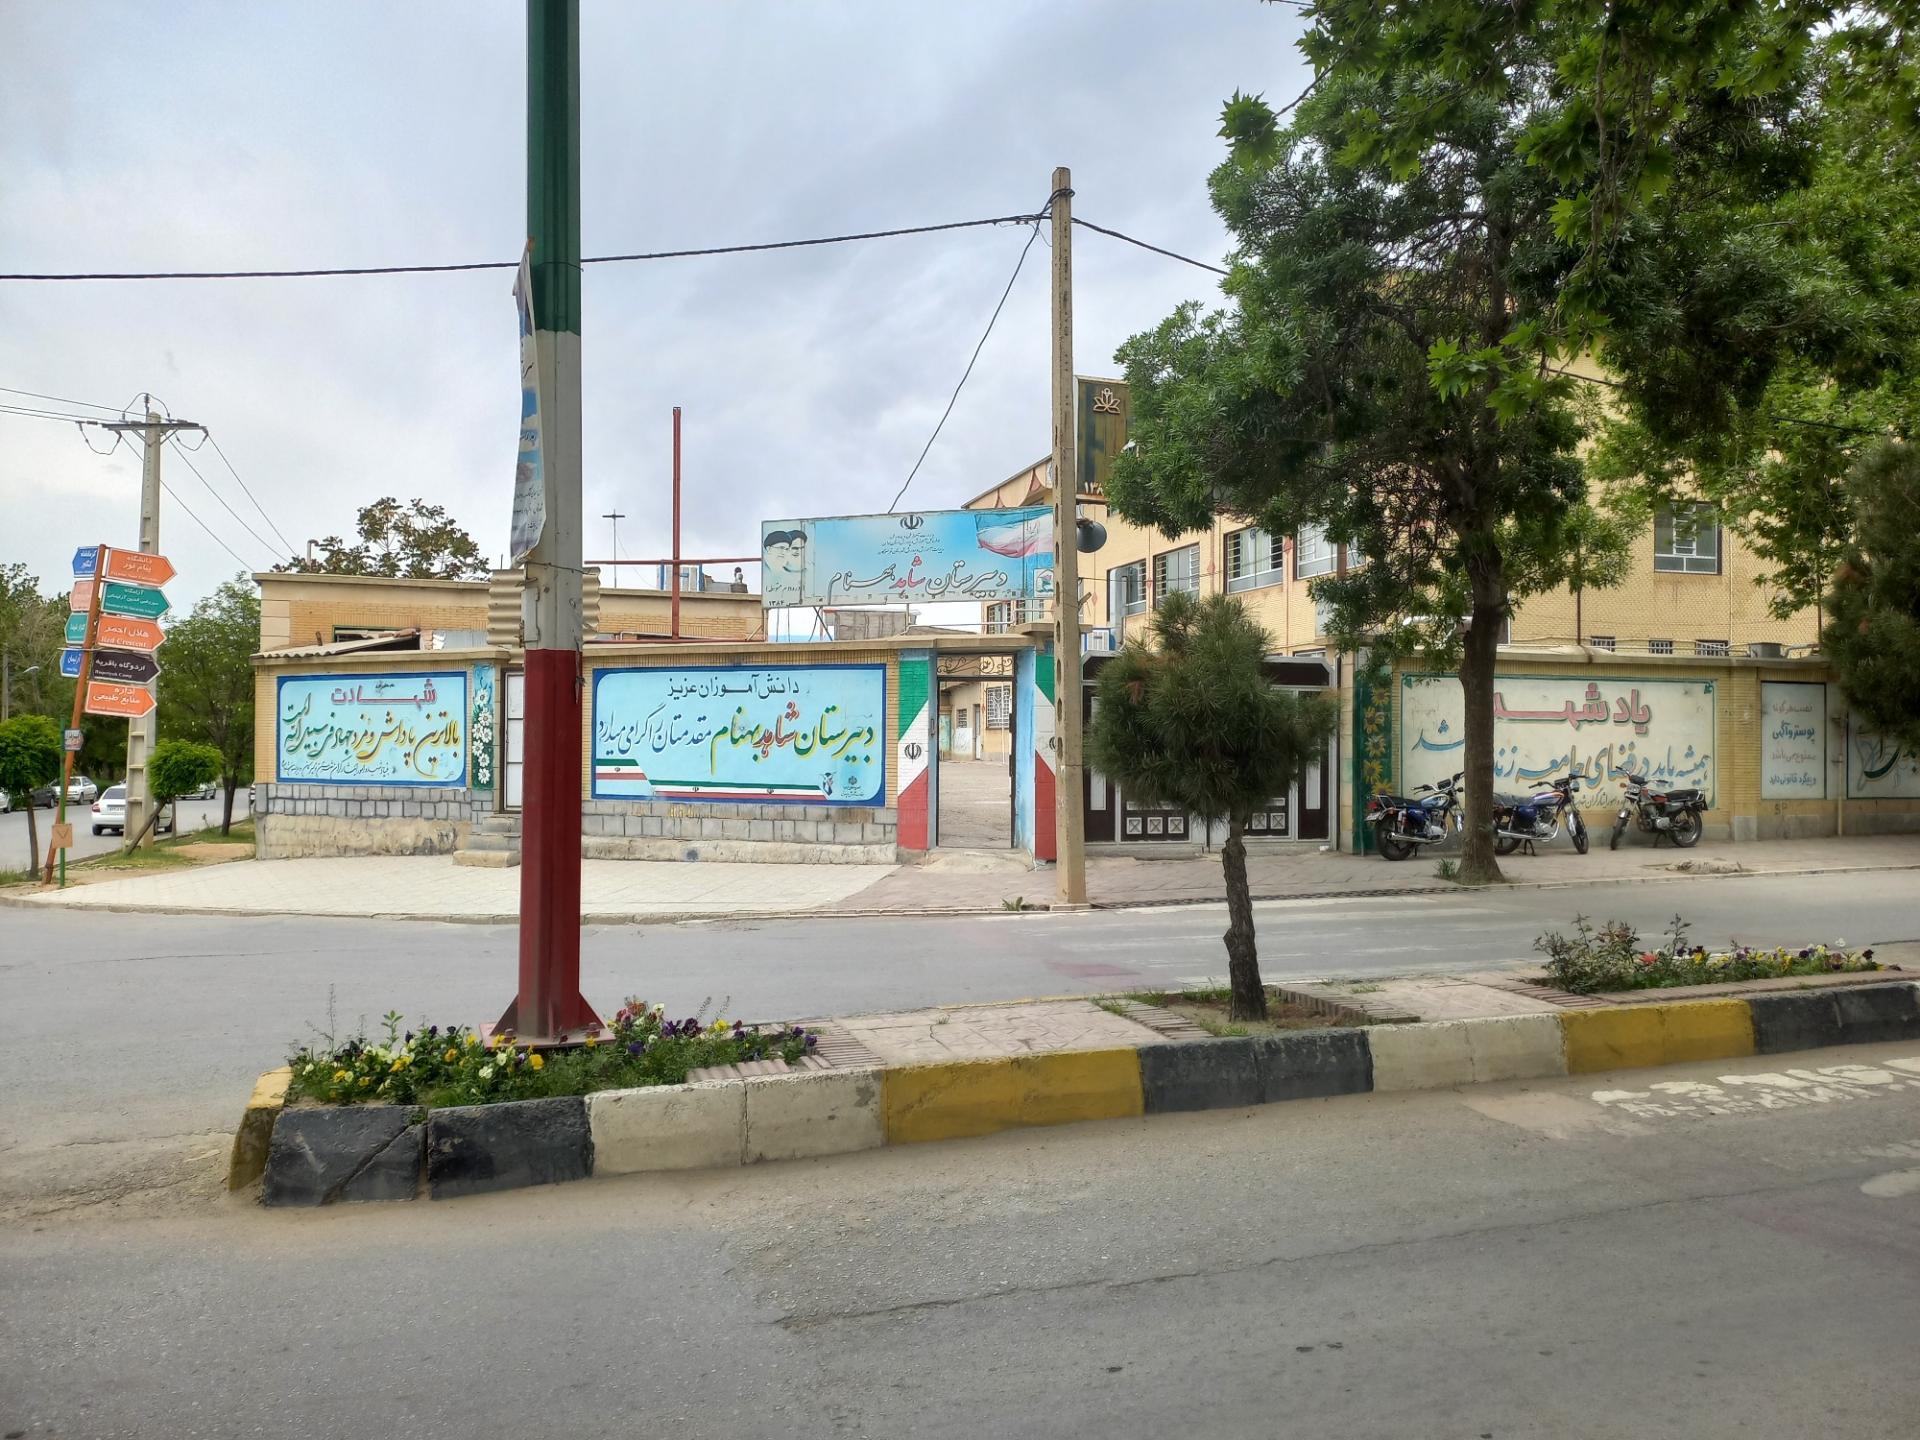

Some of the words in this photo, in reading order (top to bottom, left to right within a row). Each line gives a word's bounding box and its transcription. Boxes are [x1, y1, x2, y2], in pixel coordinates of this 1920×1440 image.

[122, 562, 136, 571] نور
[126, 554, 153, 565] دانشگاه
[136, 563, 152, 573] پیام
[828, 562, 897, 605] بهنام
[890, 555, 925, 599] شاهد
[925, 559, 1008, 598] دبیرستان
[103, 625, 127, 635] احمر
[128, 628, 150, 638] هلال
[95, 658, 117, 668] باقریه
[118, 661, 146, 672] اردوگاه
[92, 693, 119, 702] طبیعی
[114, 686, 136, 696] اداره
[120, 695, 141, 706] منابع
[331, 678, 438, 711] شهادت
[667, 677, 697, 701] عزیز
[698, 674, 760, 698] آموزان
[758, 673, 800, 700] دانش
[282, 692, 312, 723] است
[1493, 682, 1611, 731] شهد
[1612, 687, 1652, 737] یاد
[356, 710, 416, 766] پاداش
[413, 711, 460, 778] بالاترین
[651, 713, 712, 753] مقدمتان
[710, 705, 762, 777] بهنام
[753, 701, 800, 758] شاهد
[793, 704, 876, 764] دبیرستان
[1411, 719, 1465, 752] شد
[1772, 720, 1791, 740] آگهی
[1793, 725, 1815, 745] پوستر
[1494, 746, 1519, 778] زند
[1515, 745, 1586, 788] جامعه
[1585, 741, 1639, 790] فضای
[1637, 752, 1652, 776] در
[1652, 744, 1677, 788] باید
[1676, 743, 1712, 786] همیشه
[1781, 773, 1798, 785] قانونی
